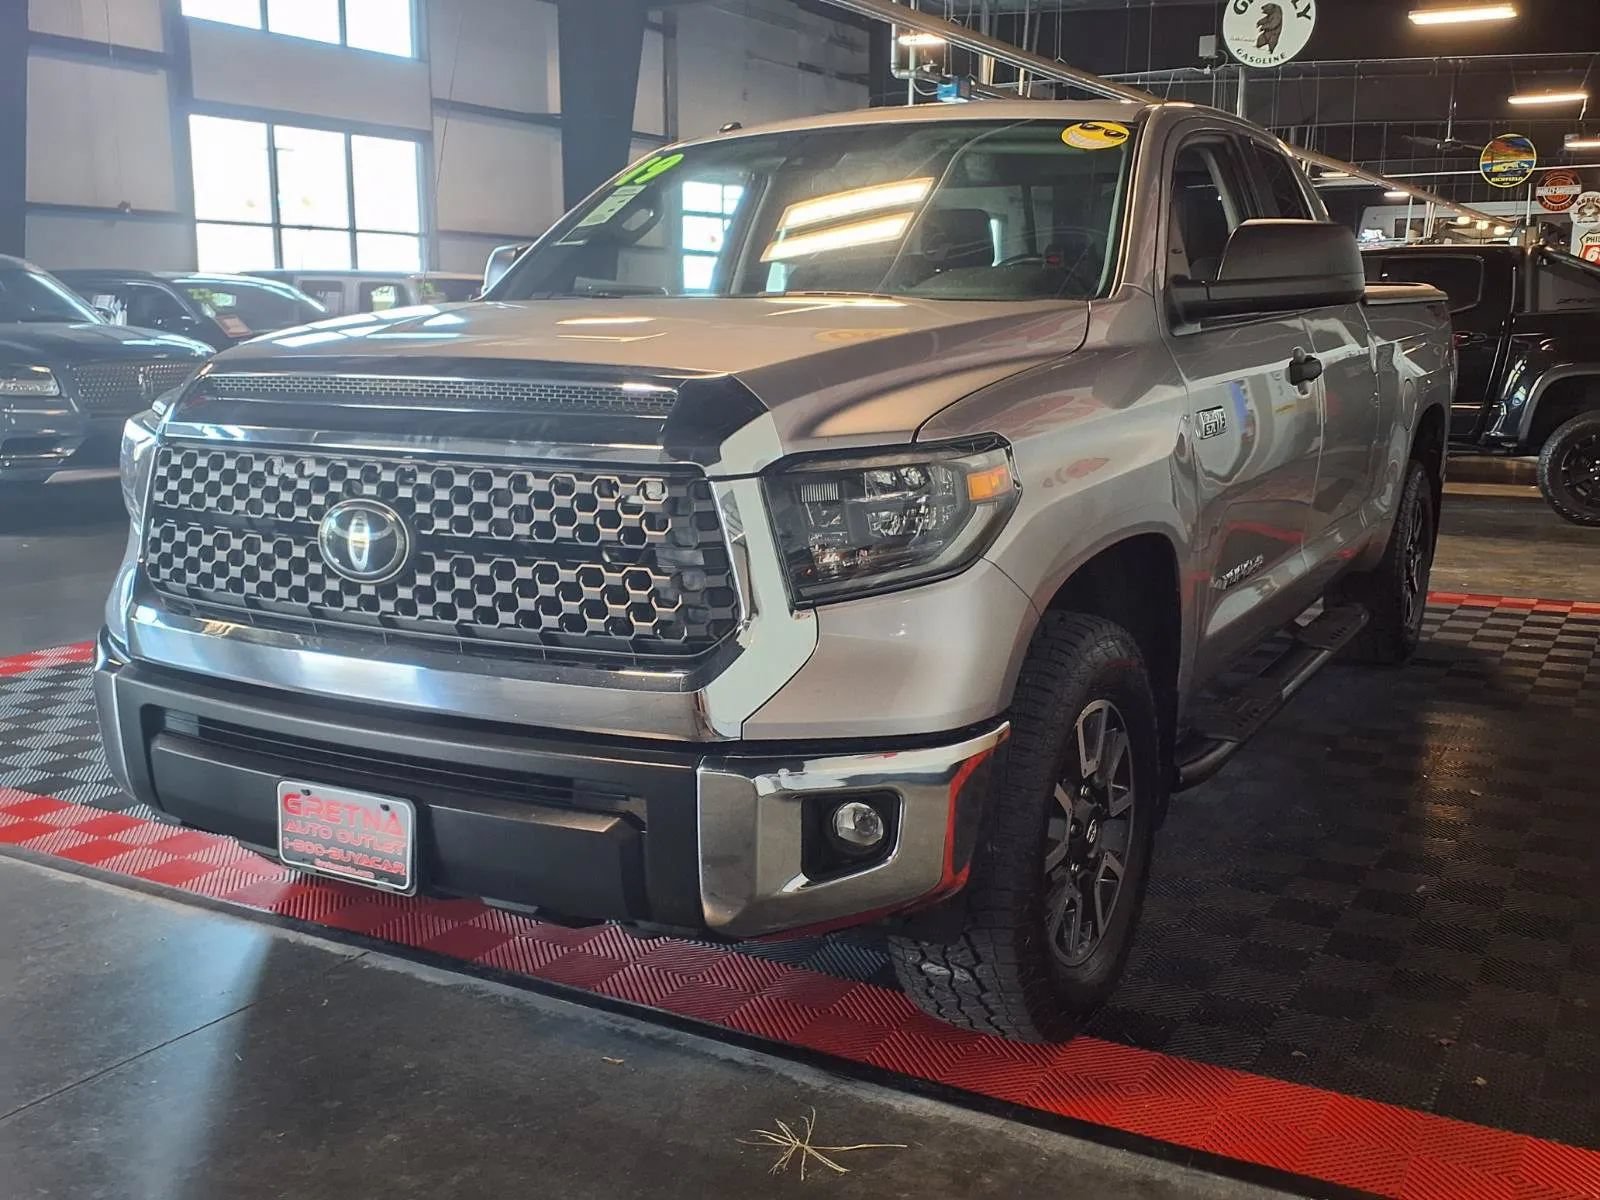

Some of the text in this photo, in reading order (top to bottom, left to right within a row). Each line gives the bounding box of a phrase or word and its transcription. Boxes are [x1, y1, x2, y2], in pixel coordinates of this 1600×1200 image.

[1236, 48, 1285, 64] GASOLINE
[283, 793, 404, 837] GRETNA
[283, 818, 406, 855] AUTO OUTLET
